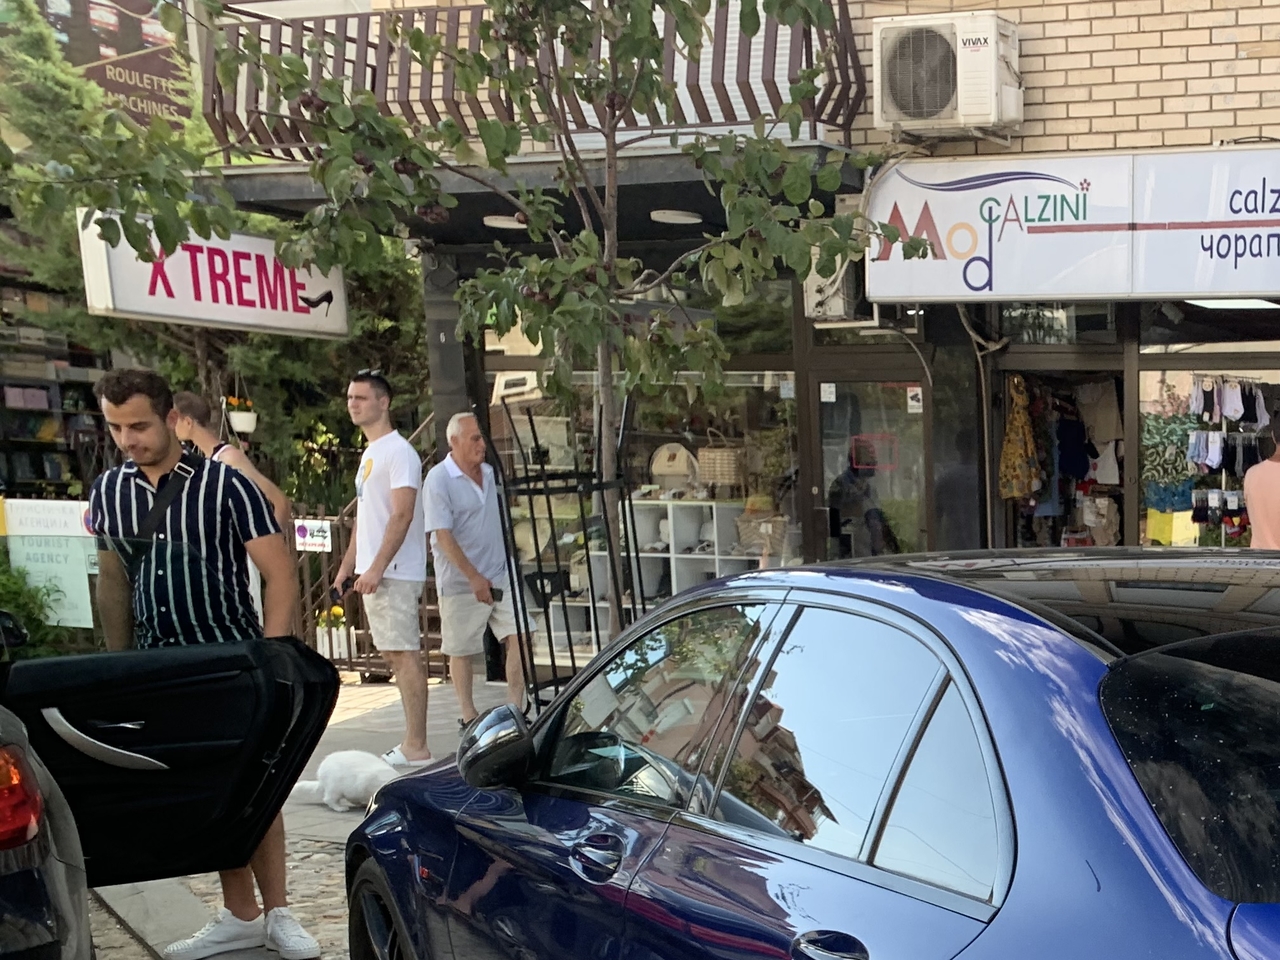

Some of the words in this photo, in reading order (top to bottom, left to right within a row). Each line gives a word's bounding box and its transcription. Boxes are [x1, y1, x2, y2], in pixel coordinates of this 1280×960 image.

[962, 37, 989, 47] VIVAX
[20, 536, 70, 548] TOURIST
[25, 552, 70, 565] AGENCY
